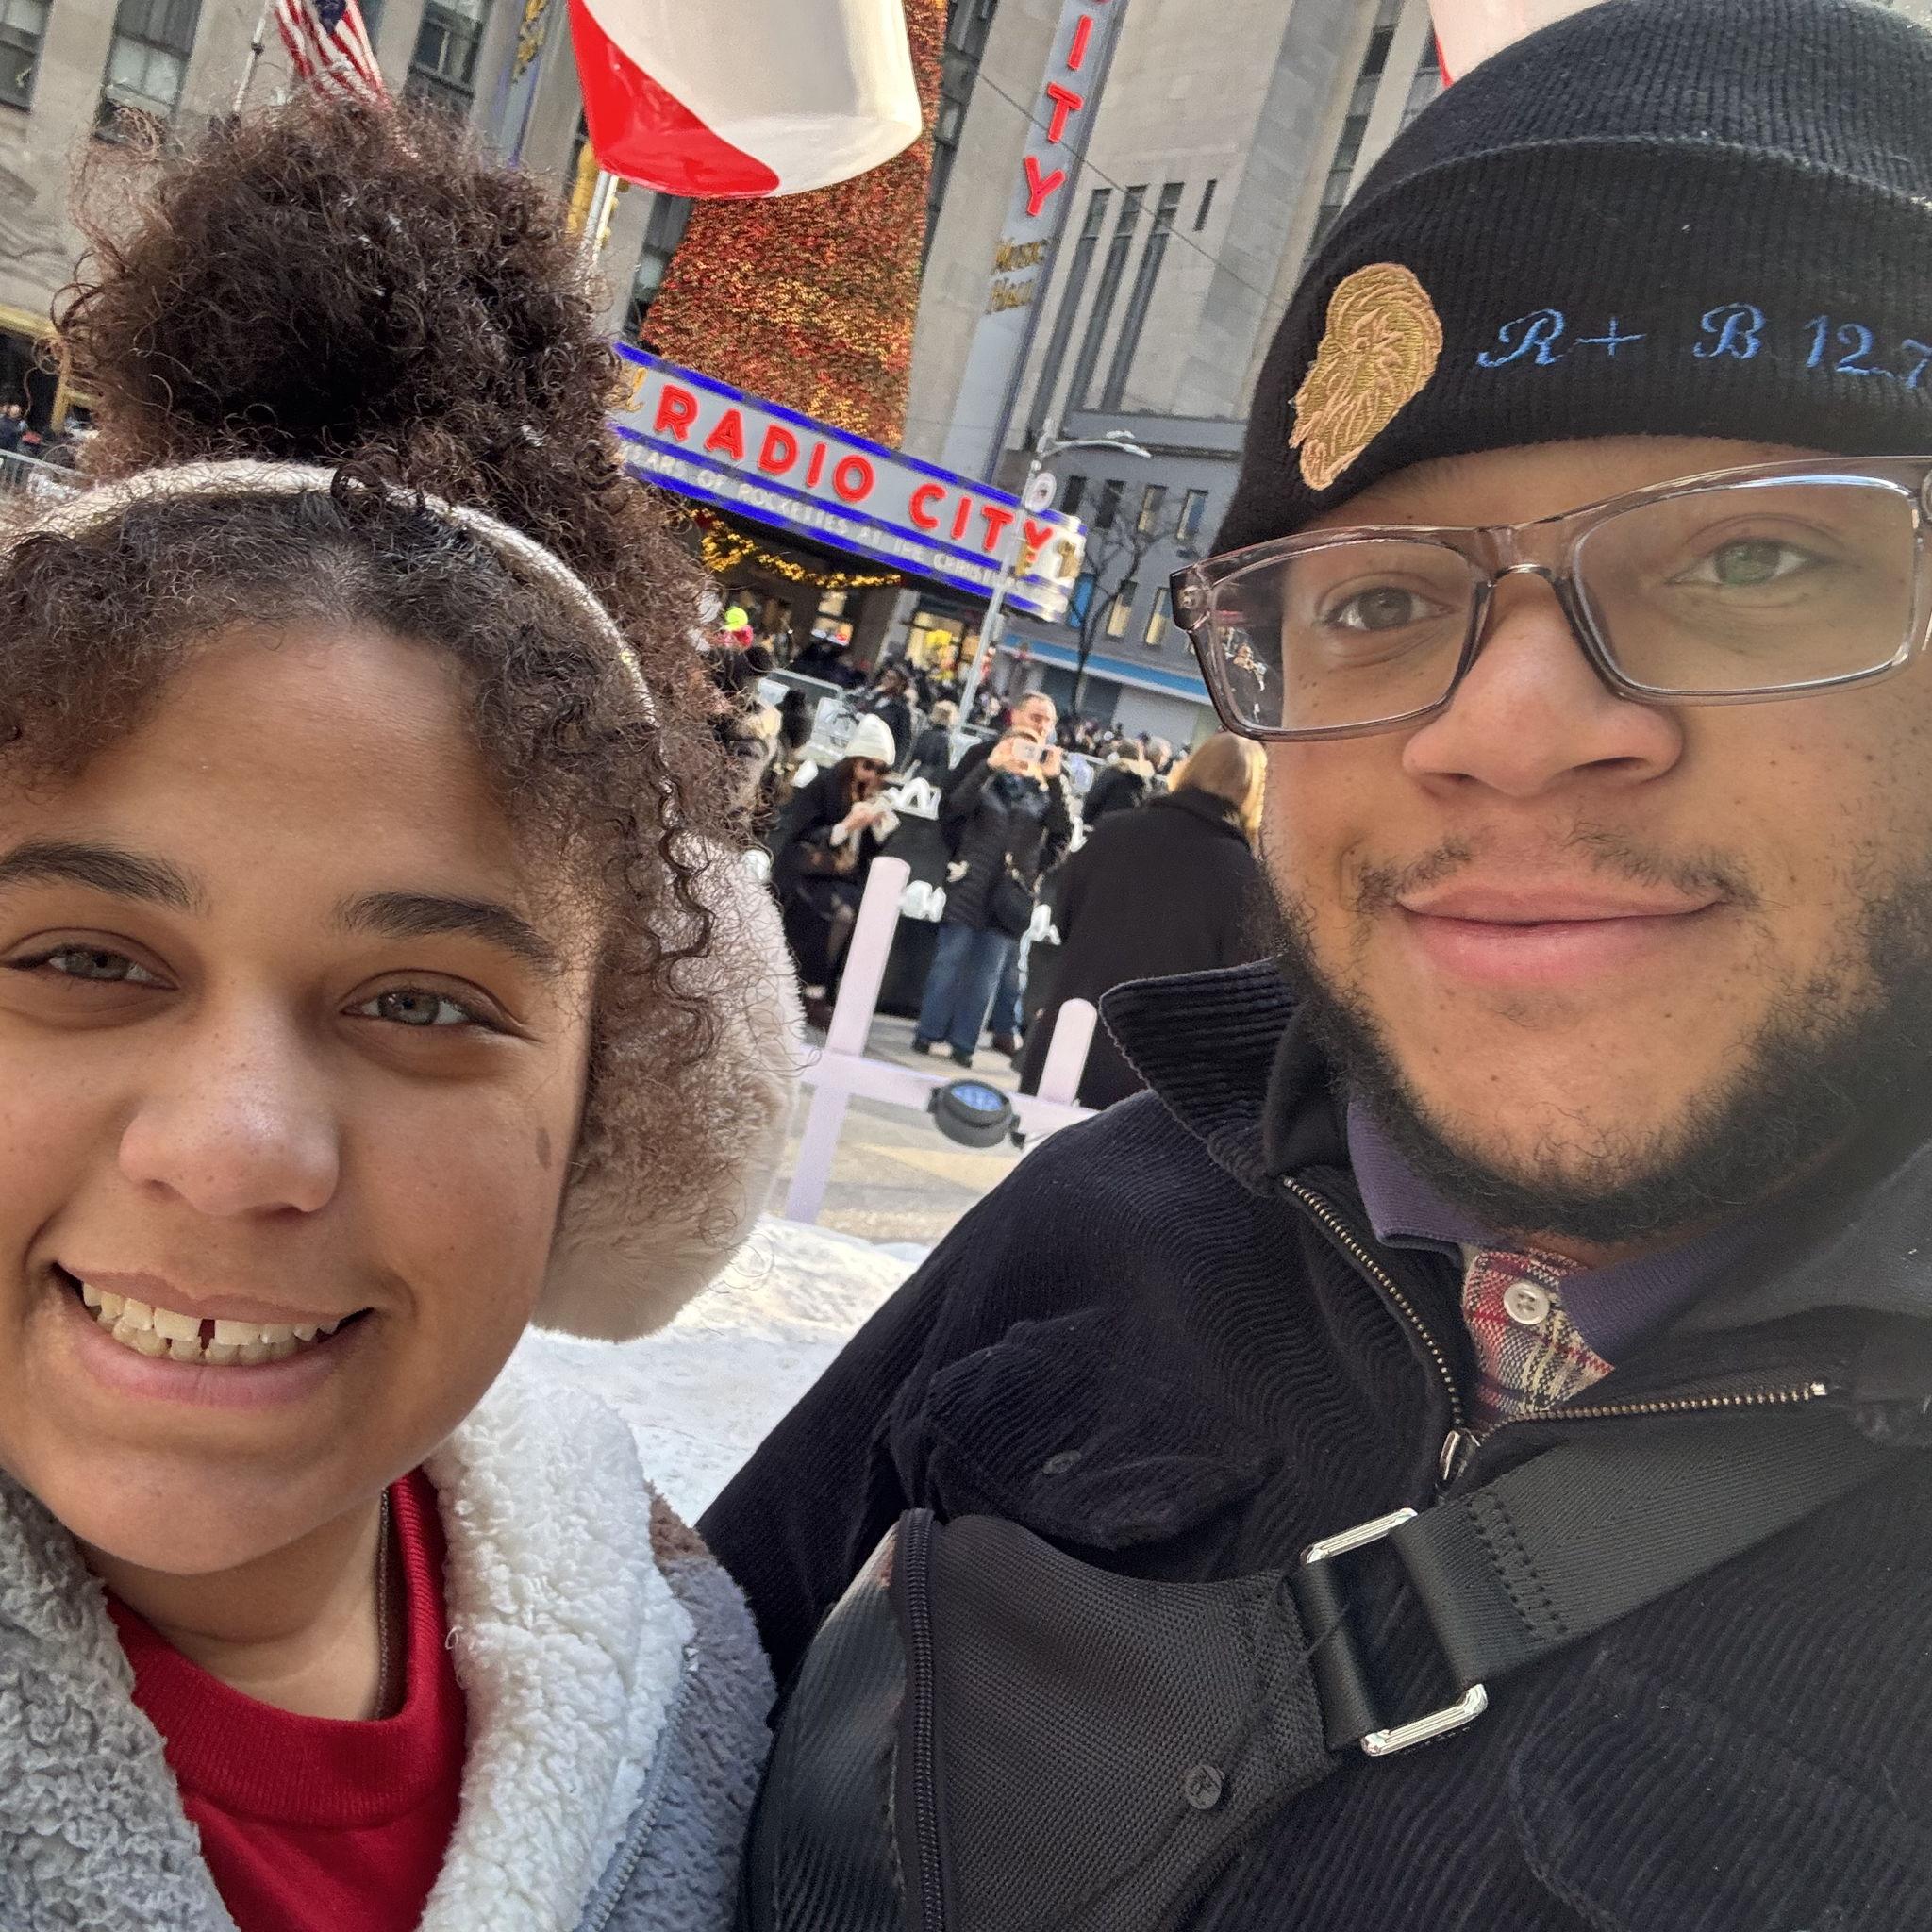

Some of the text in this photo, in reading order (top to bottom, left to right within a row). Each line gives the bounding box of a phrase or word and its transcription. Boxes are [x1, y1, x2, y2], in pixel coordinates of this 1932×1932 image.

[1024, 0, 1111, 217] ITY
[1693, 302, 1765, 360] B
[653, 383, 1054, 563] RADIO CITY
